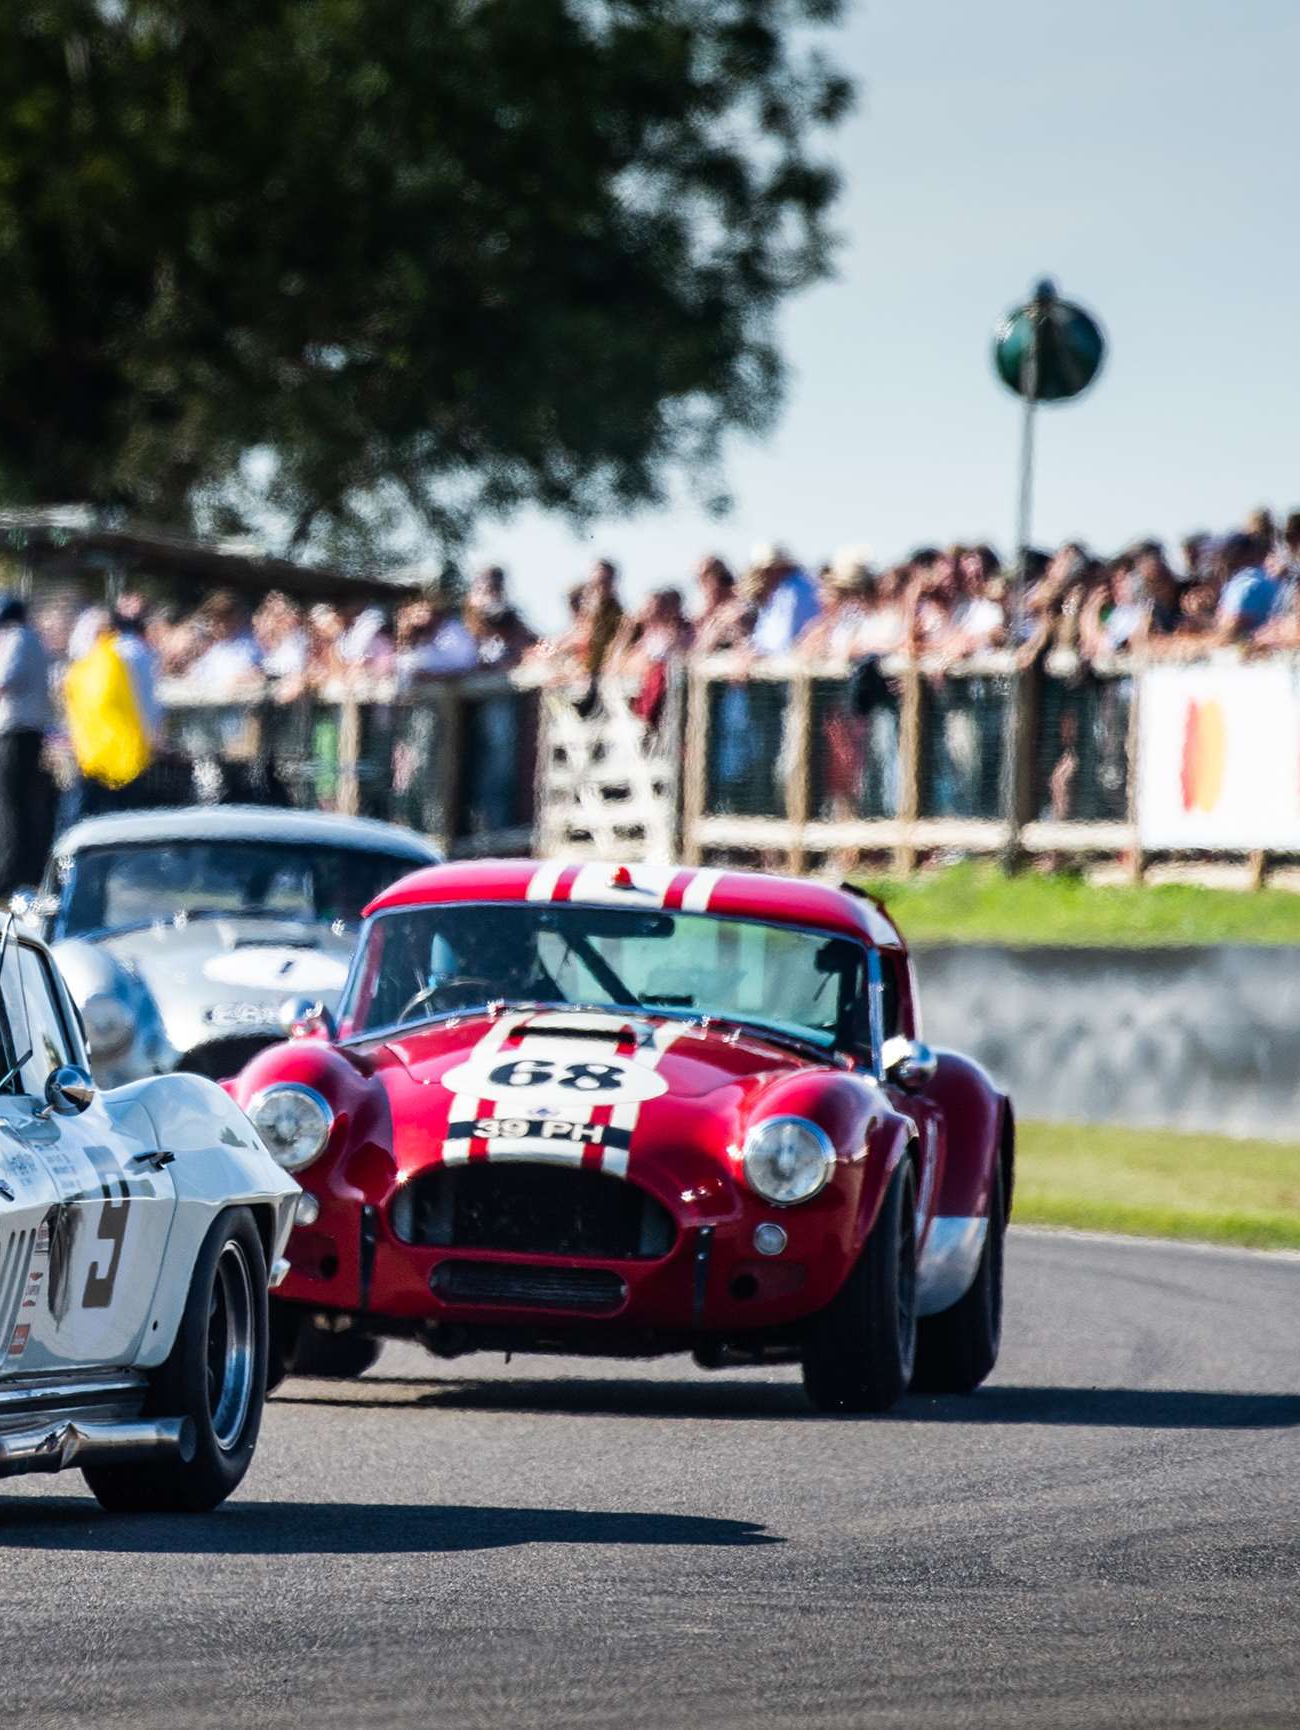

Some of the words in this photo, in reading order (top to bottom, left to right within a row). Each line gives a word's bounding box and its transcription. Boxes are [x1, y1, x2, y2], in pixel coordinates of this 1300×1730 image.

[489, 1060, 626, 1092] 68
[473, 1118, 531, 1139] 39
[540, 1121, 605, 1144] PH
